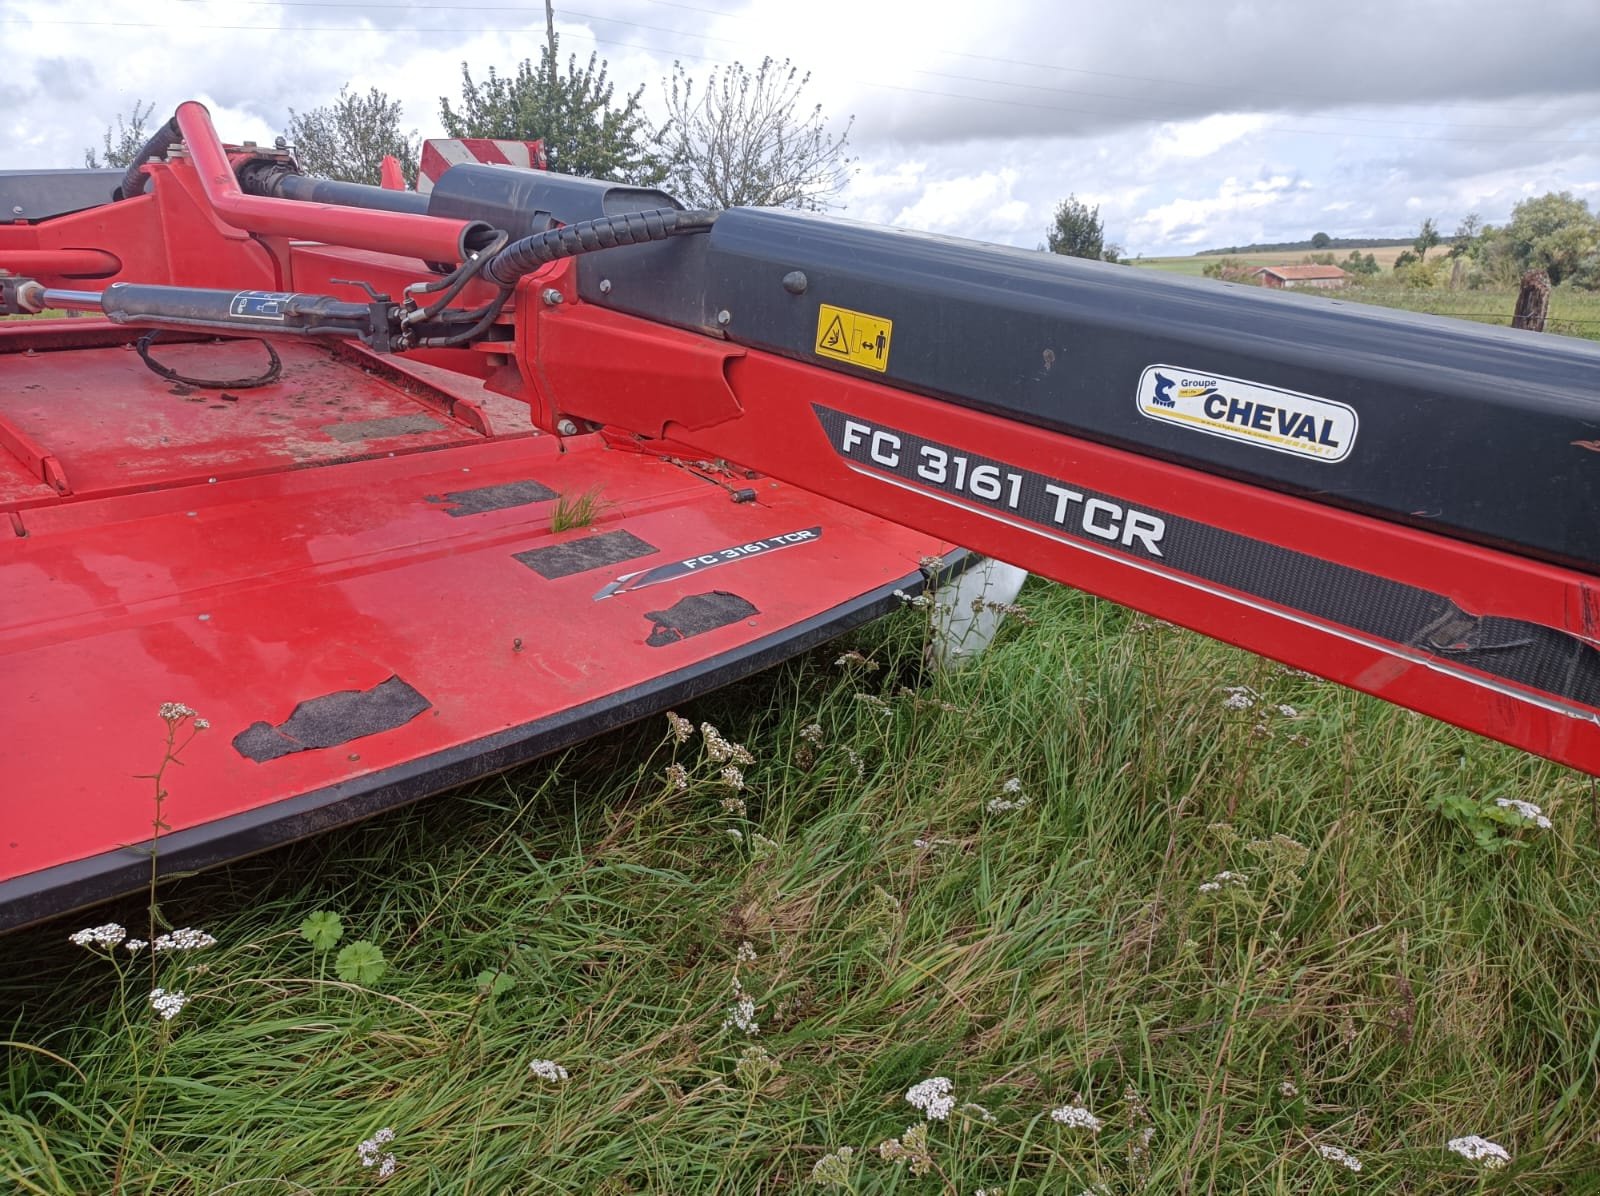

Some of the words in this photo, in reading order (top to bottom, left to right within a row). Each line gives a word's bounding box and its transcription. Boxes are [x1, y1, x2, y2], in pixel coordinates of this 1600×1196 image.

[1181, 379, 1217, 389] Groupe
[1203, 393, 1340, 448] CHEVAL
[842, 420, 901, 467] FC
[917, 445, 1023, 508] 3161
[1046, 484, 1166, 557] TCR
[682, 555, 719, 569] FC
[720, 541, 770, 558] 3161
[769, 529, 817, 545] TCR
